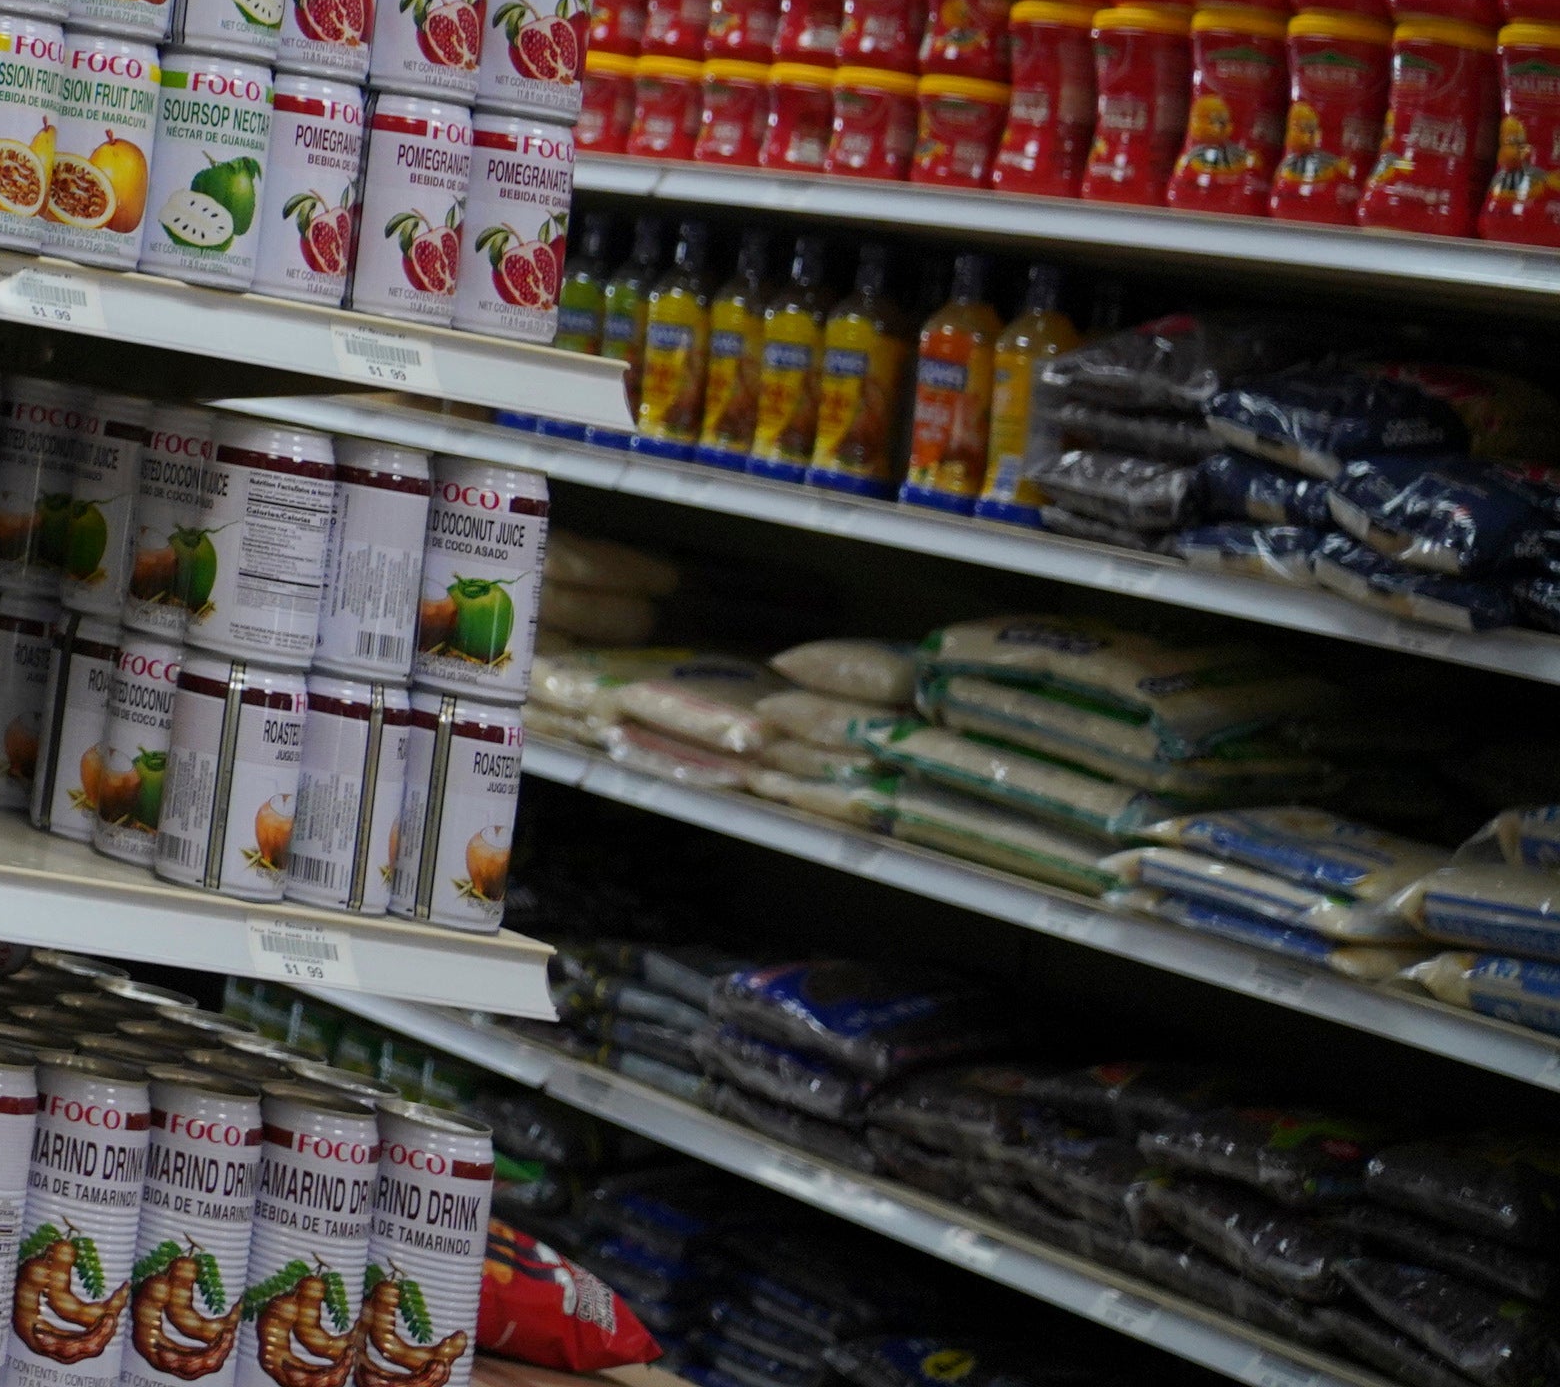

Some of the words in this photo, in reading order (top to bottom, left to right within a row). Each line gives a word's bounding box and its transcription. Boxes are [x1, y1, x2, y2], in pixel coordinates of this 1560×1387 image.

[72, 49, 142, 81] FOCO
[90, 80, 127, 111] FRUIT
[192, 72, 261, 103] FOCO
[162, 97, 224, 131] SOURSOP
[50, 1097, 121, 1131] FOCO
[170, 1114, 241, 1147] FOCO
[426, 1190, 481, 1233] DRINK
[397, 1225, 472, 1256] TAMARINDO
